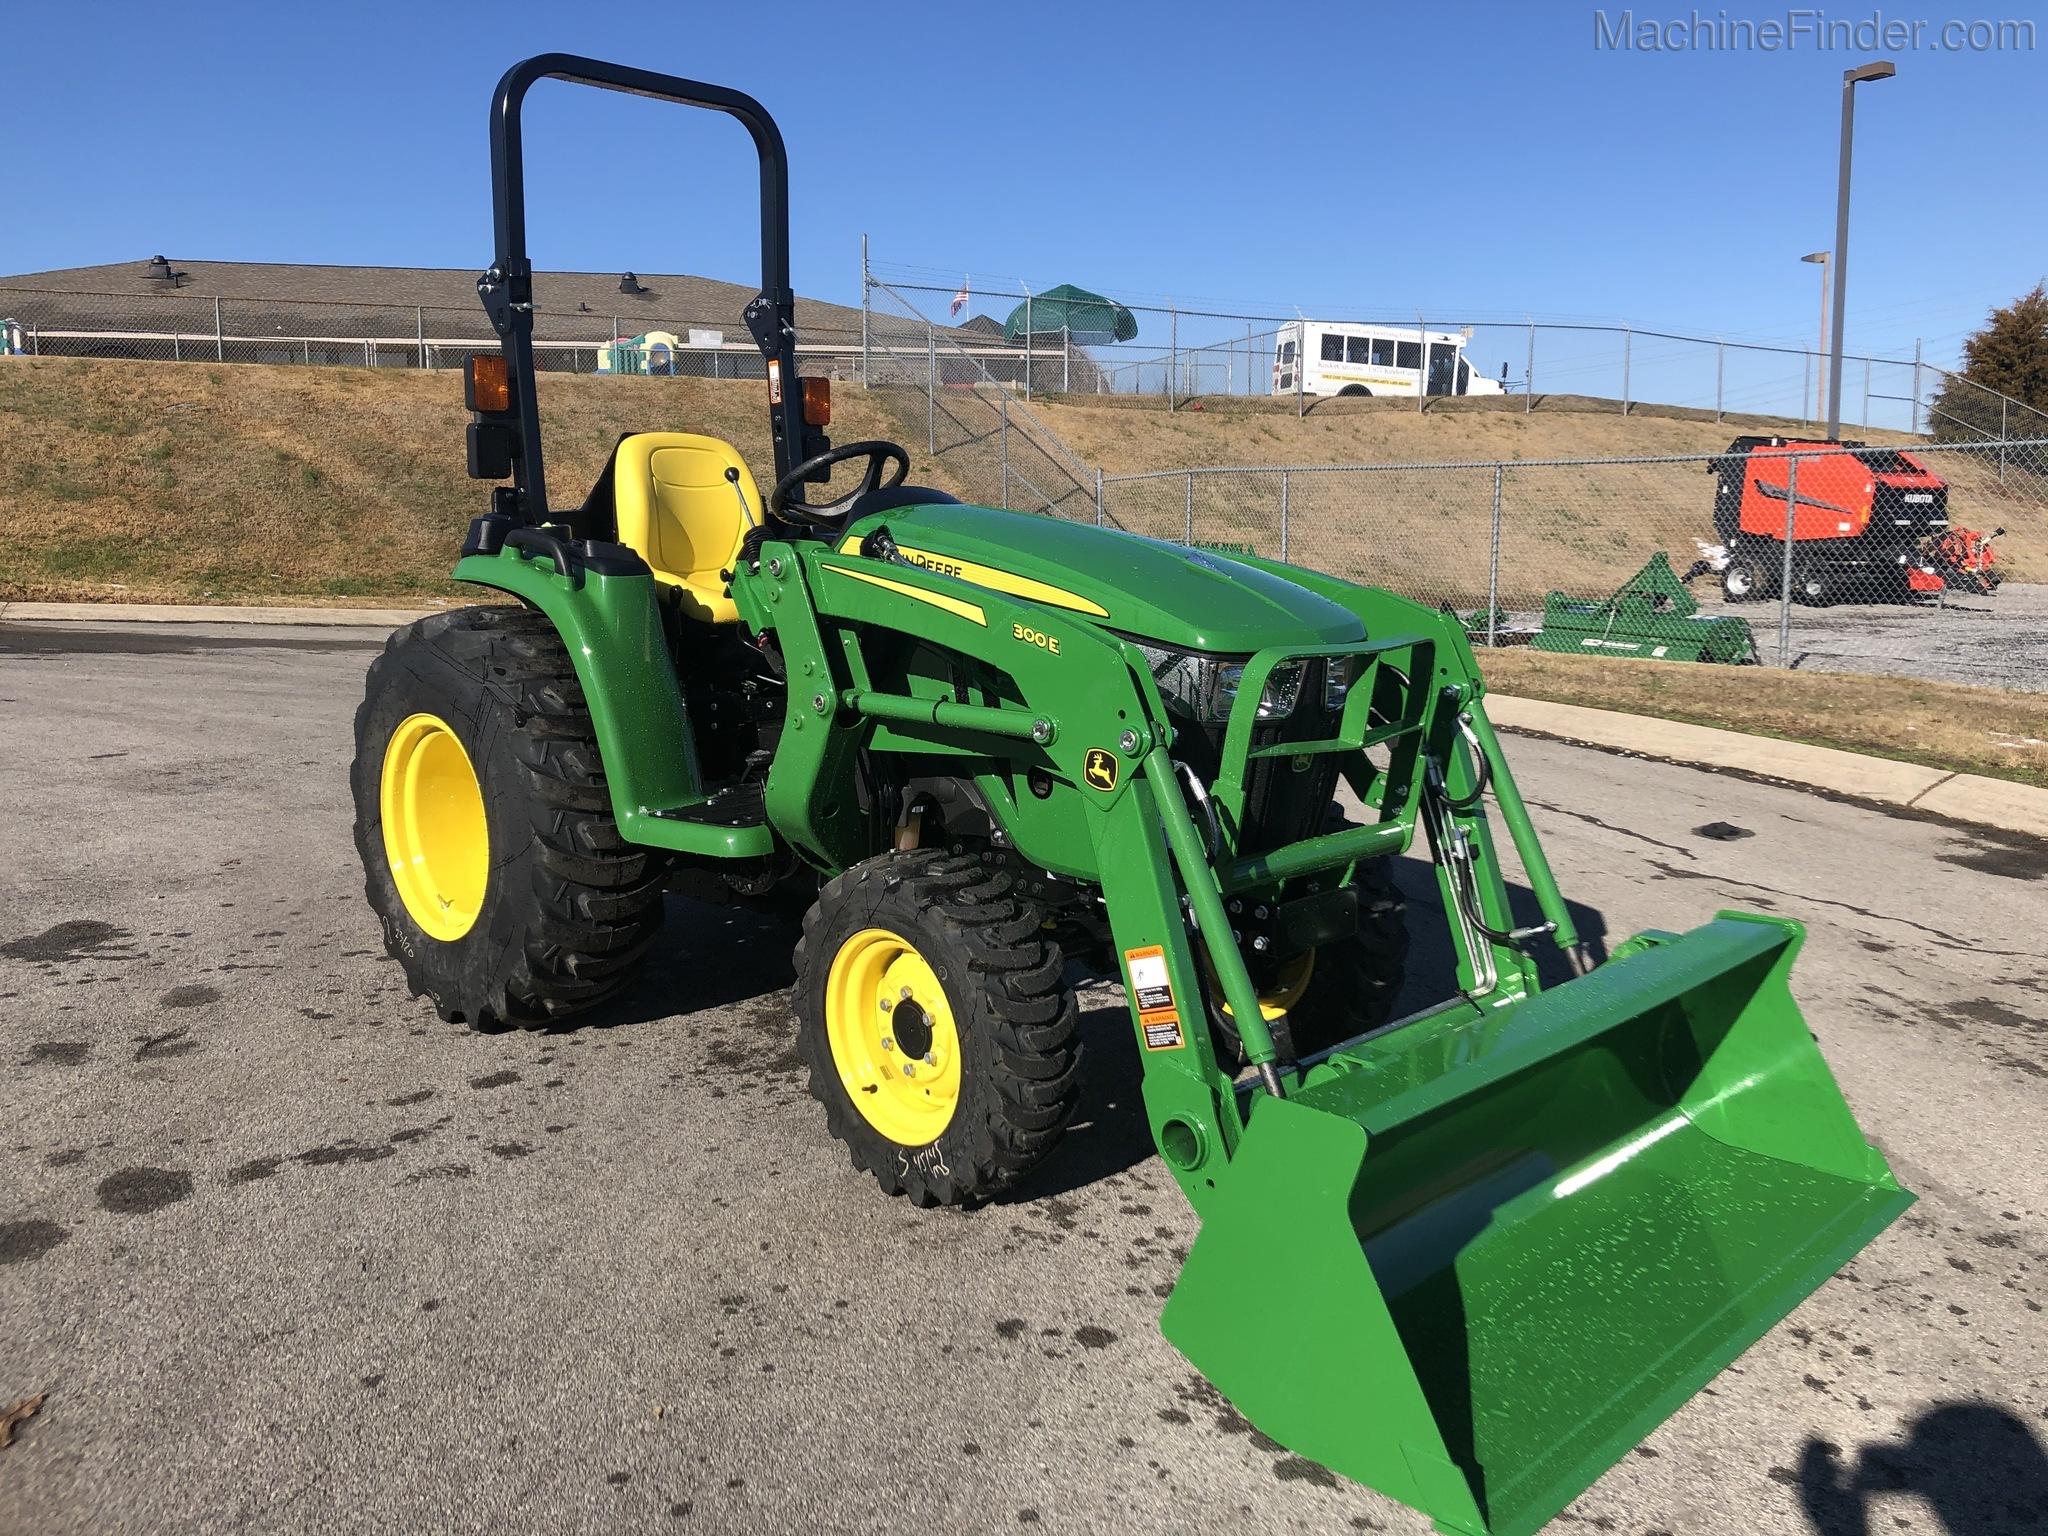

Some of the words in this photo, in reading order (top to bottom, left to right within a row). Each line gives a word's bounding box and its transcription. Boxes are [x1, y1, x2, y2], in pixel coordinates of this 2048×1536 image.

[1904, 493, 1933, 504] KUBOTA
[1135, 948, 1159, 958] WARNING
[1150, 1014, 1175, 1022] WARNING
